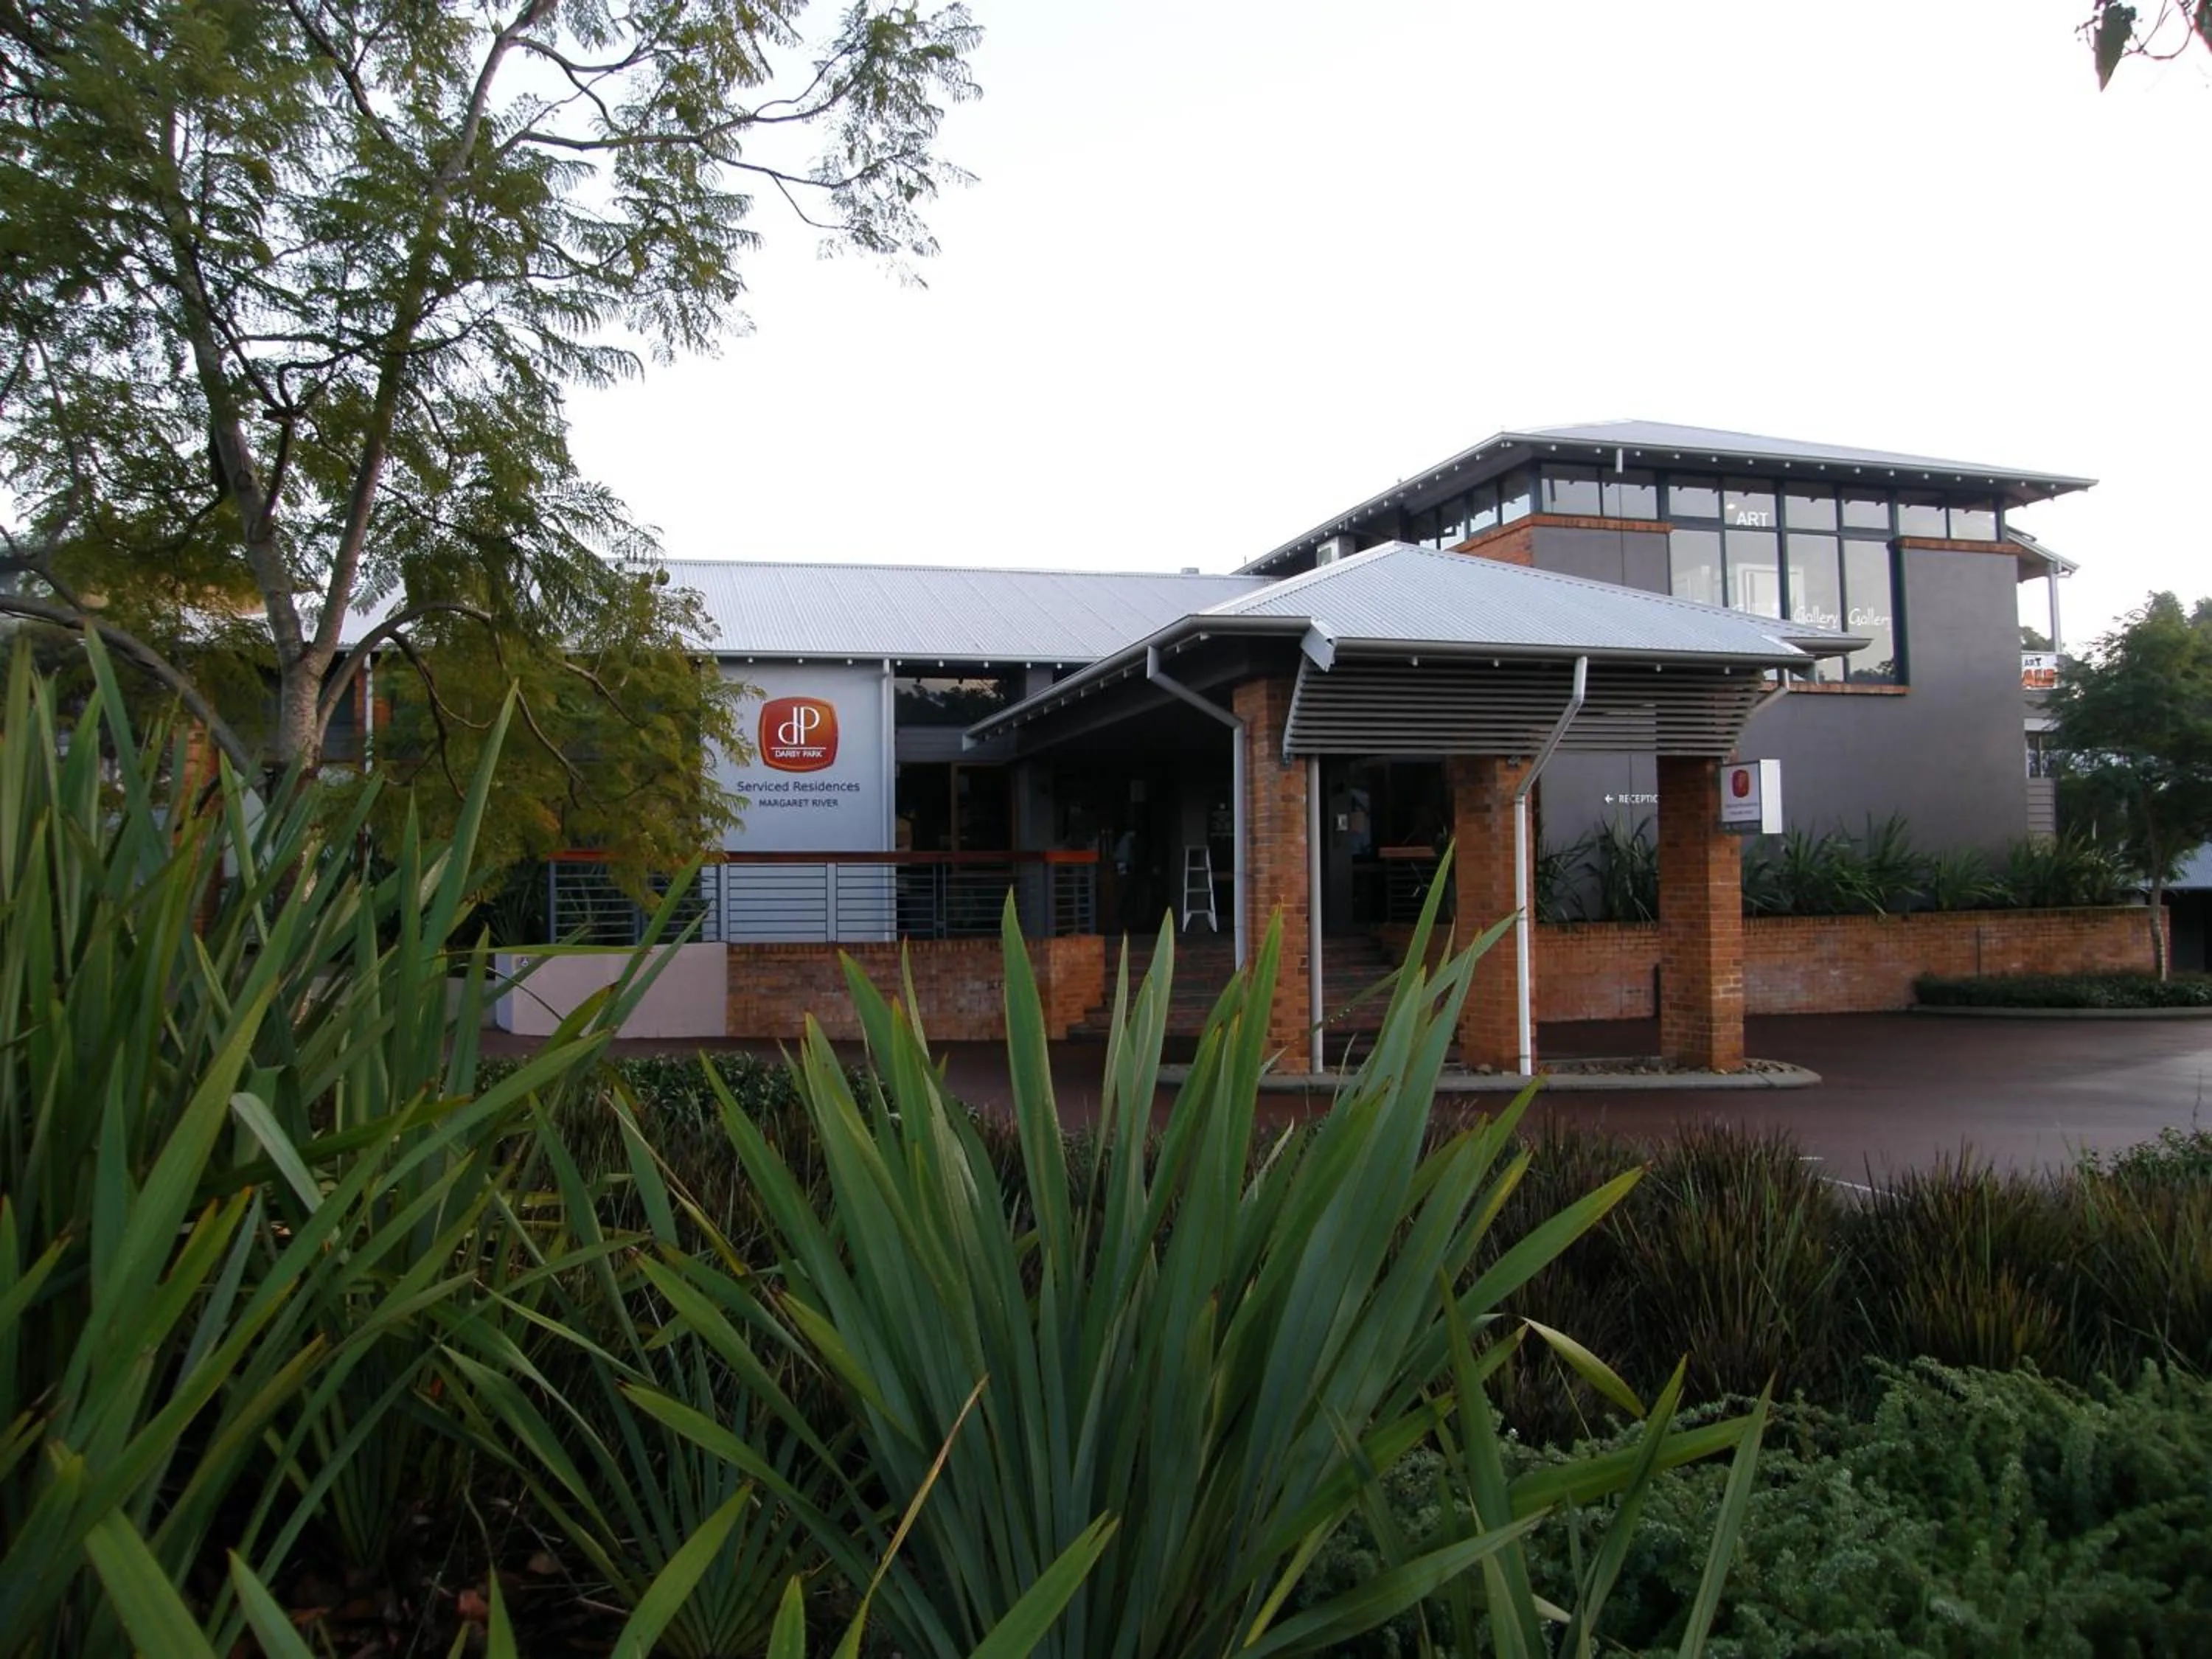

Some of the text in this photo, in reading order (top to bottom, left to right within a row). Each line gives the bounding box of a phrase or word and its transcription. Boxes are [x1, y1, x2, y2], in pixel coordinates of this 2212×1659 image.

[1736, 511, 1769, 526] ART
[1793, 605, 1838, 629] Gallery
[775, 750, 823, 758] DARBY PARK
[737, 781, 860, 792] Serviced Residences
[759, 799, 838, 807] MARGARET RIVER
